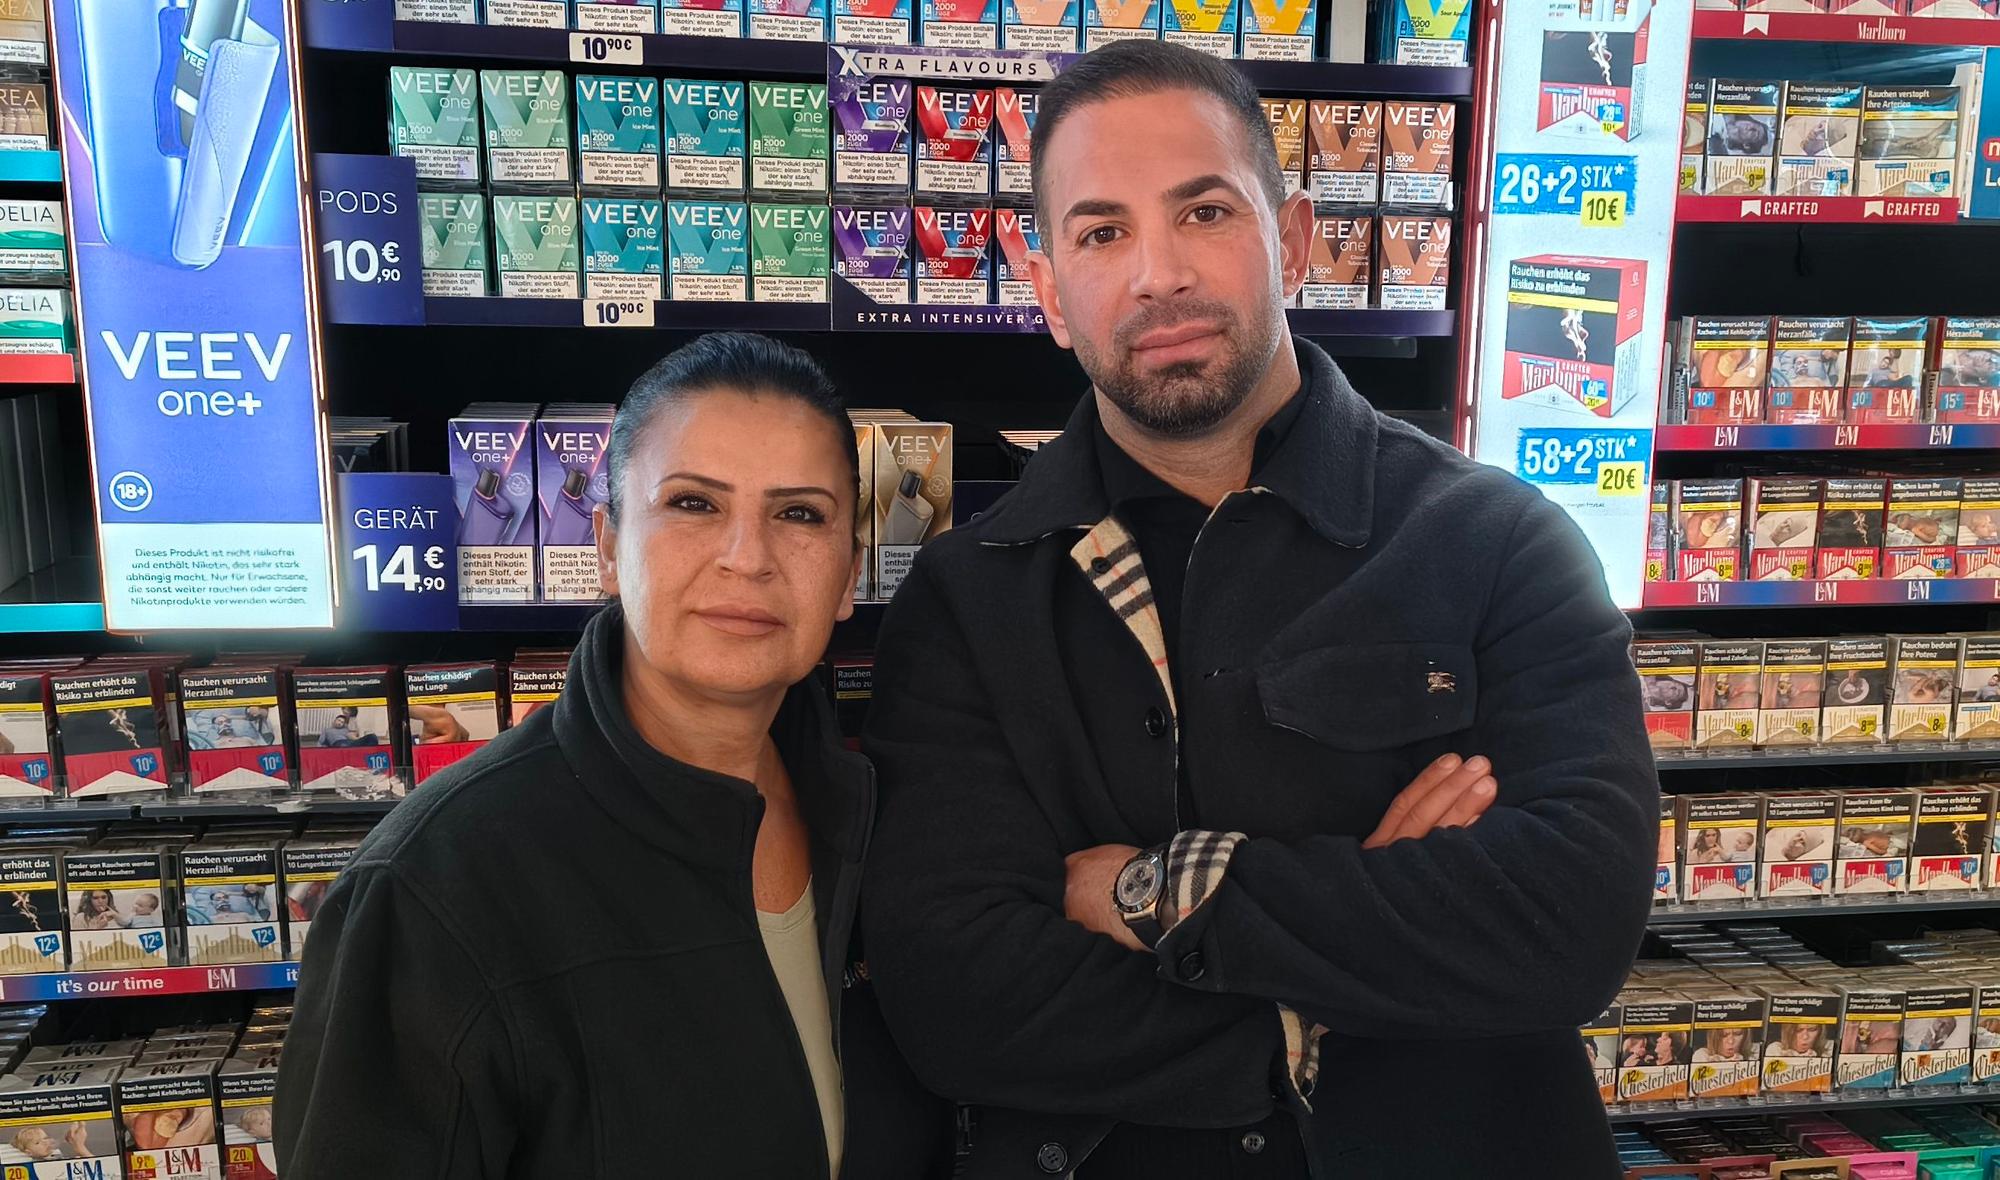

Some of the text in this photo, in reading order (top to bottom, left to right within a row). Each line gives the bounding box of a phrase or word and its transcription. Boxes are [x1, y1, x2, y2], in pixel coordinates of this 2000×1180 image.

[1857, 18, 1906, 41] Marlboro
[920, 60, 1038, 75] FLAVOURS
[395, 72, 472, 95] VEEV
[484, 75, 560, 97] VEEV
[579, 80, 654, 102] VEEV
[667, 84, 740, 107] VEEV
[753, 87, 825, 109] VEEV
[920, 91, 990, 113] VEEV
[1868, 89, 1930, 100] Rauchen verstopft
[622, 105, 652, 117] one
[708, 108, 738, 121] one
[793, 111, 823, 123] one
[1314, 104, 1380, 126] VEEV
[1388, 105, 1455, 127] VEEV
[1499, 163, 1578, 204] 26+2
[319, 190, 398, 215] PODS
[497, 201, 573, 223] VEEV
[1586, 198, 1618, 221] 10€
[1764, 201, 1819, 215] CRAFTED
[1886, 202, 1940, 216] CRAFTED
[584, 203, 658, 224] VEEV
[670, 206, 743, 226] VEEV
[754, 208, 826, 229] VEEV
[837, 211, 908, 231] VEEV
[918, 211, 989, 231] VEEV
[1385, 220, 1451, 240] VEEV
[322, 239, 378, 283] 10
[1511, 265, 1545, 279] Rauchen
[1574, 270, 1591, 282] das
[857, 312, 912, 323] EXTRA
[922, 312, 1025, 324] INTENSIVER
[1779, 320, 1808, 329] Rauchen
[1809, 320, 1844, 329] verursacht
[100, 331, 292, 382] VEEV
[157, 390, 263, 417] one+
[1729, 390, 1760, 418] L&M
[1808, 390, 1839, 418] L&M
[1887, 389, 1917, 417] L&M
[455, 430, 527, 451] VEEV
[885, 434, 948, 453] VEEV
[1714, 426, 1739, 447] L&M
[1834, 425, 1859, 446] L&M
[1929, 425, 1953, 445] L&M
[472, 452, 512, 464] one+
[559, 451, 598, 464] one+
[896, 454, 932, 466] one+
[1523, 437, 1594, 475] 58+2
[1602, 468, 1637, 490] 20€
[116, 484, 146, 500] 18+
[354, 506, 439, 530] GERÄT
[135, 548, 167, 557] Dieses
[170, 549, 208, 558] Produkt
[211, 549, 224, 557] ist
[226, 548, 251, 557] nicht
[462, 551, 528, 561] Dieses Produkt
[132, 561, 150, 569] und
[153, 561, 190, 569] enthält
[232, 561, 249, 569] das
[252, 561, 272, 569] sehr
[275, 561, 300, 569] stark
[352, 543, 421, 592] 14
[462, 560, 528, 569] enthält Nikotin:
[462, 568, 528, 579] einen Stoff, der
[126, 573, 172, 583] abhängig
[211, 573, 228, 581] Nur
[475, 577, 517, 585] sehr stark
[128, 585, 307, 593] die sonst weiter rauchen oder andere
[1697, 583, 1720, 603] L&M
[1815, 581, 1838, 601] L&M
[1908, 580, 1930, 600] L&M
[131, 597, 211, 606] Nikotinprodukte
[214, 597, 267, 605] verwenden
[54, 676, 137, 691] Rauchen erhöht das
[183, 675, 268, 688] Rauchen verursacht
[408, 671, 473, 684] Rauchen schädigt
[513, 671, 547, 681] Rauchen
[837, 670, 871, 679] Rauchen
[56, 687, 135, 701] Risiko zu erblinden
[184, 687, 234, 698] Herzanfälle
[408, 683, 448, 693] Ihre Lunge
[513, 681, 555, 691] Zähne und
[2, 859, 51, 870] erhöht das
[185, 853, 267, 864] Rauchen verursacht
[4, 870, 47, 880] erblinden
[185, 866, 234, 875] Herzanfälle
[56, 977, 164, 993] it's our time
[207, 968, 236, 990] L&M
[1835, 1054, 1896, 1088] Chesterfield
[1903, 1051, 1969, 1083] Chesterfield
[165, 1147, 202, 1176] L&M
